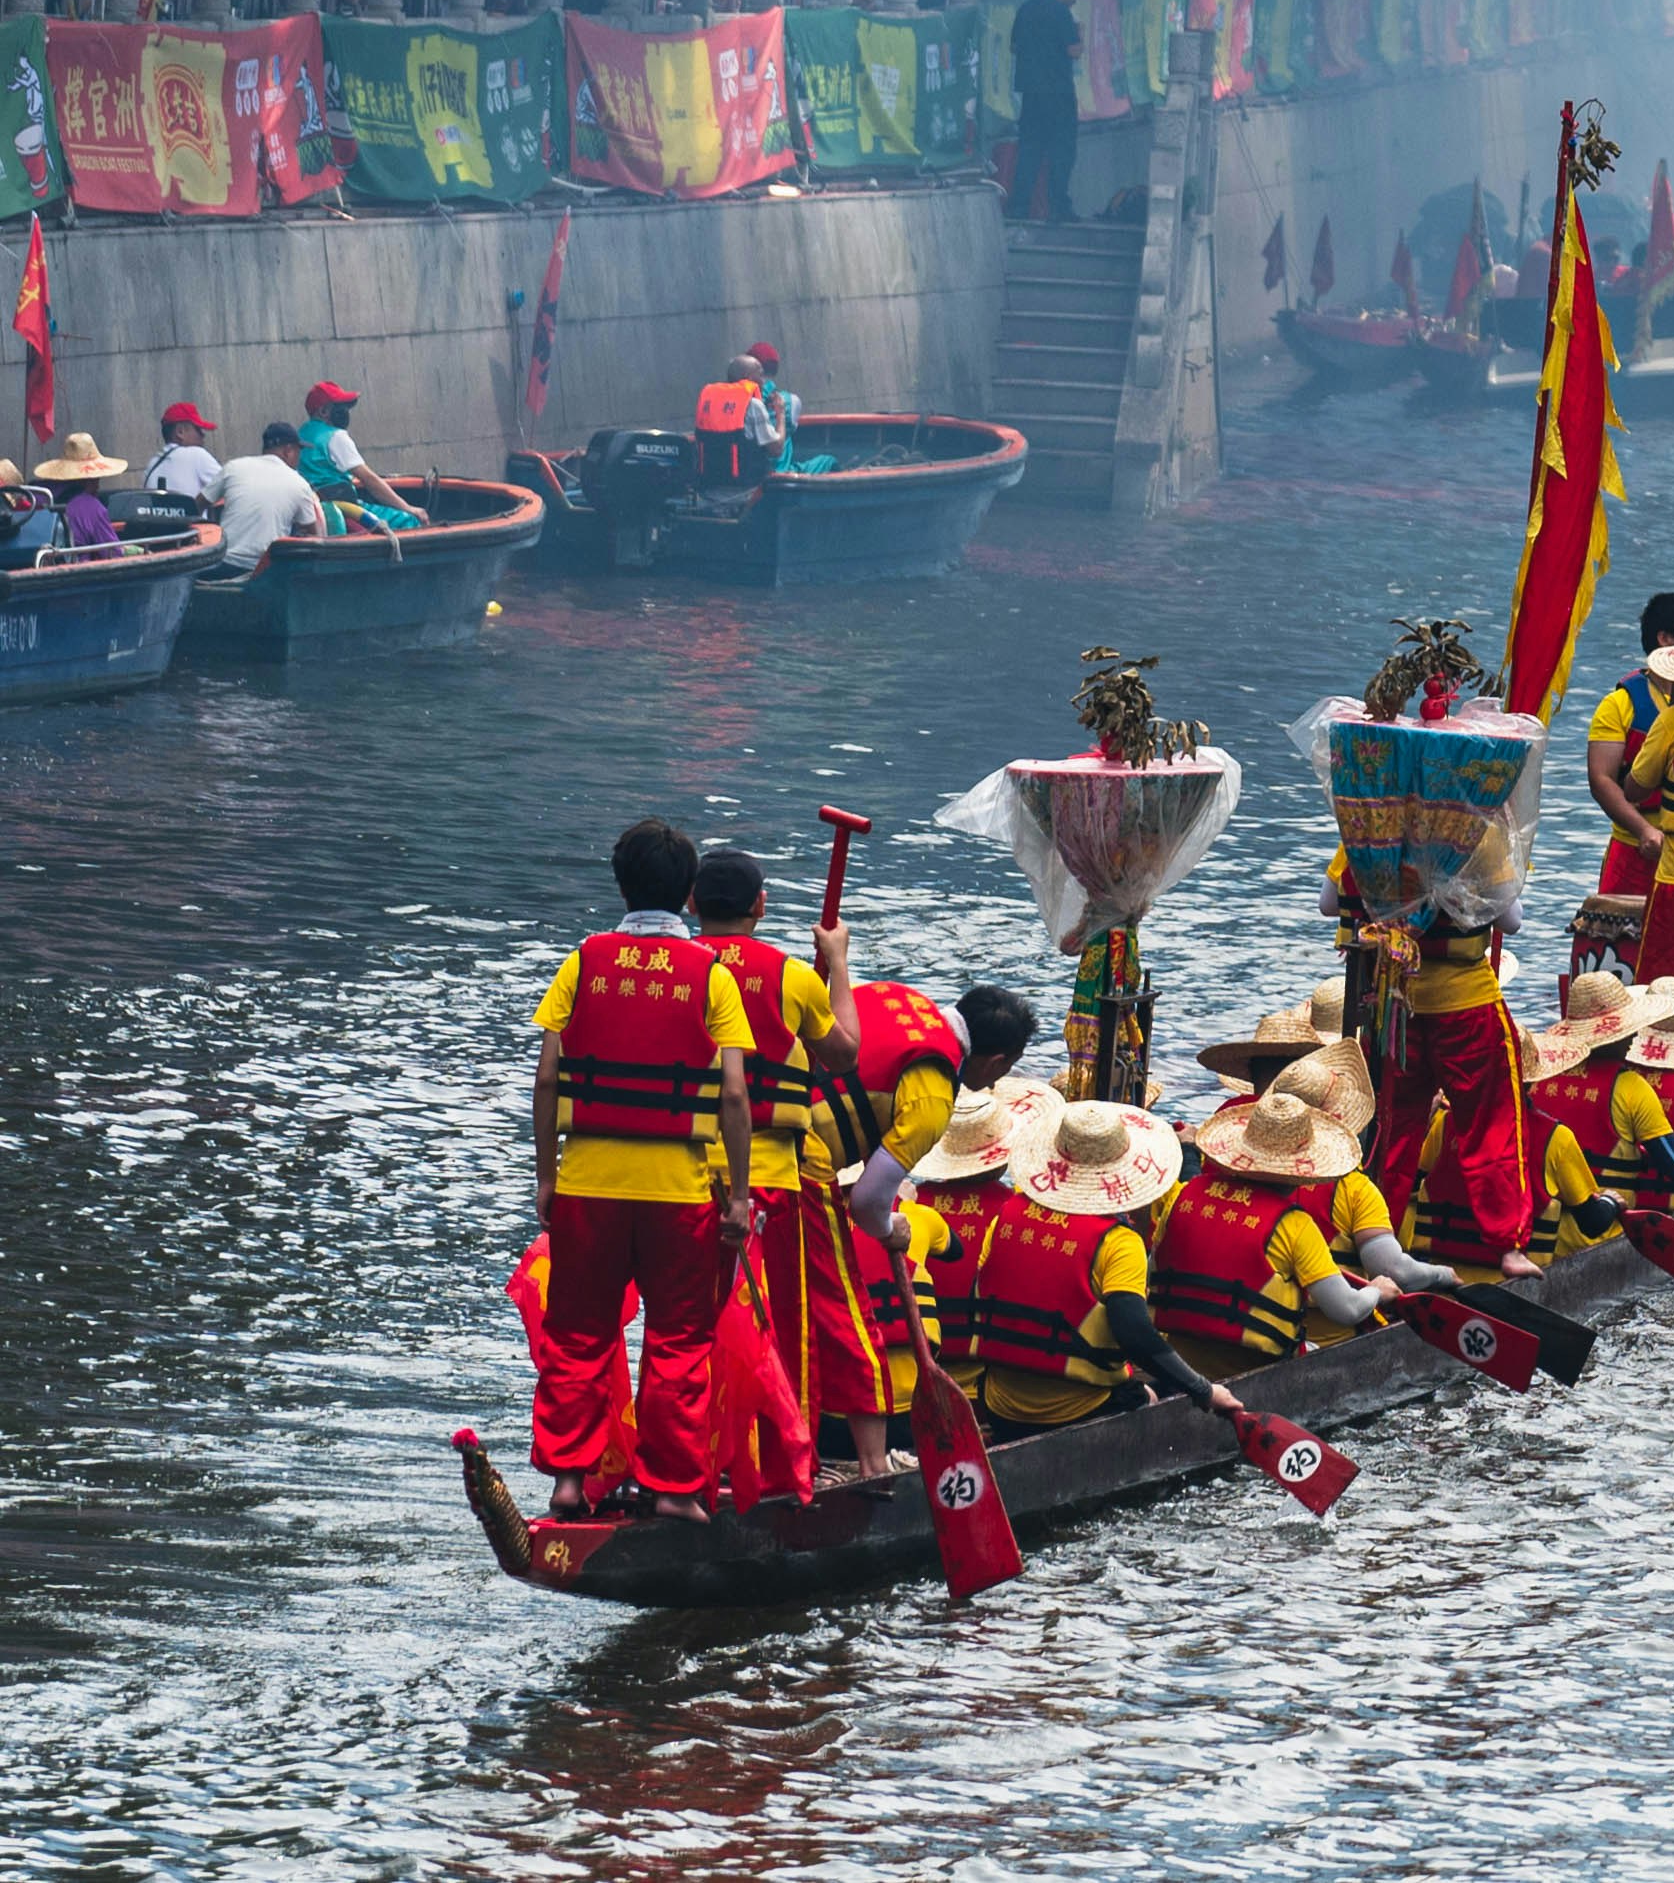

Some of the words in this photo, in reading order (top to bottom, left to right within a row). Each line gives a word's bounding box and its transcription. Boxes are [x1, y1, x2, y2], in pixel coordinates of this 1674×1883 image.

[636, 443, 679, 456] SUZUKI
[614, 946, 674, 974] 駿威
[590, 975, 692, 1003] 俱樂部贈
